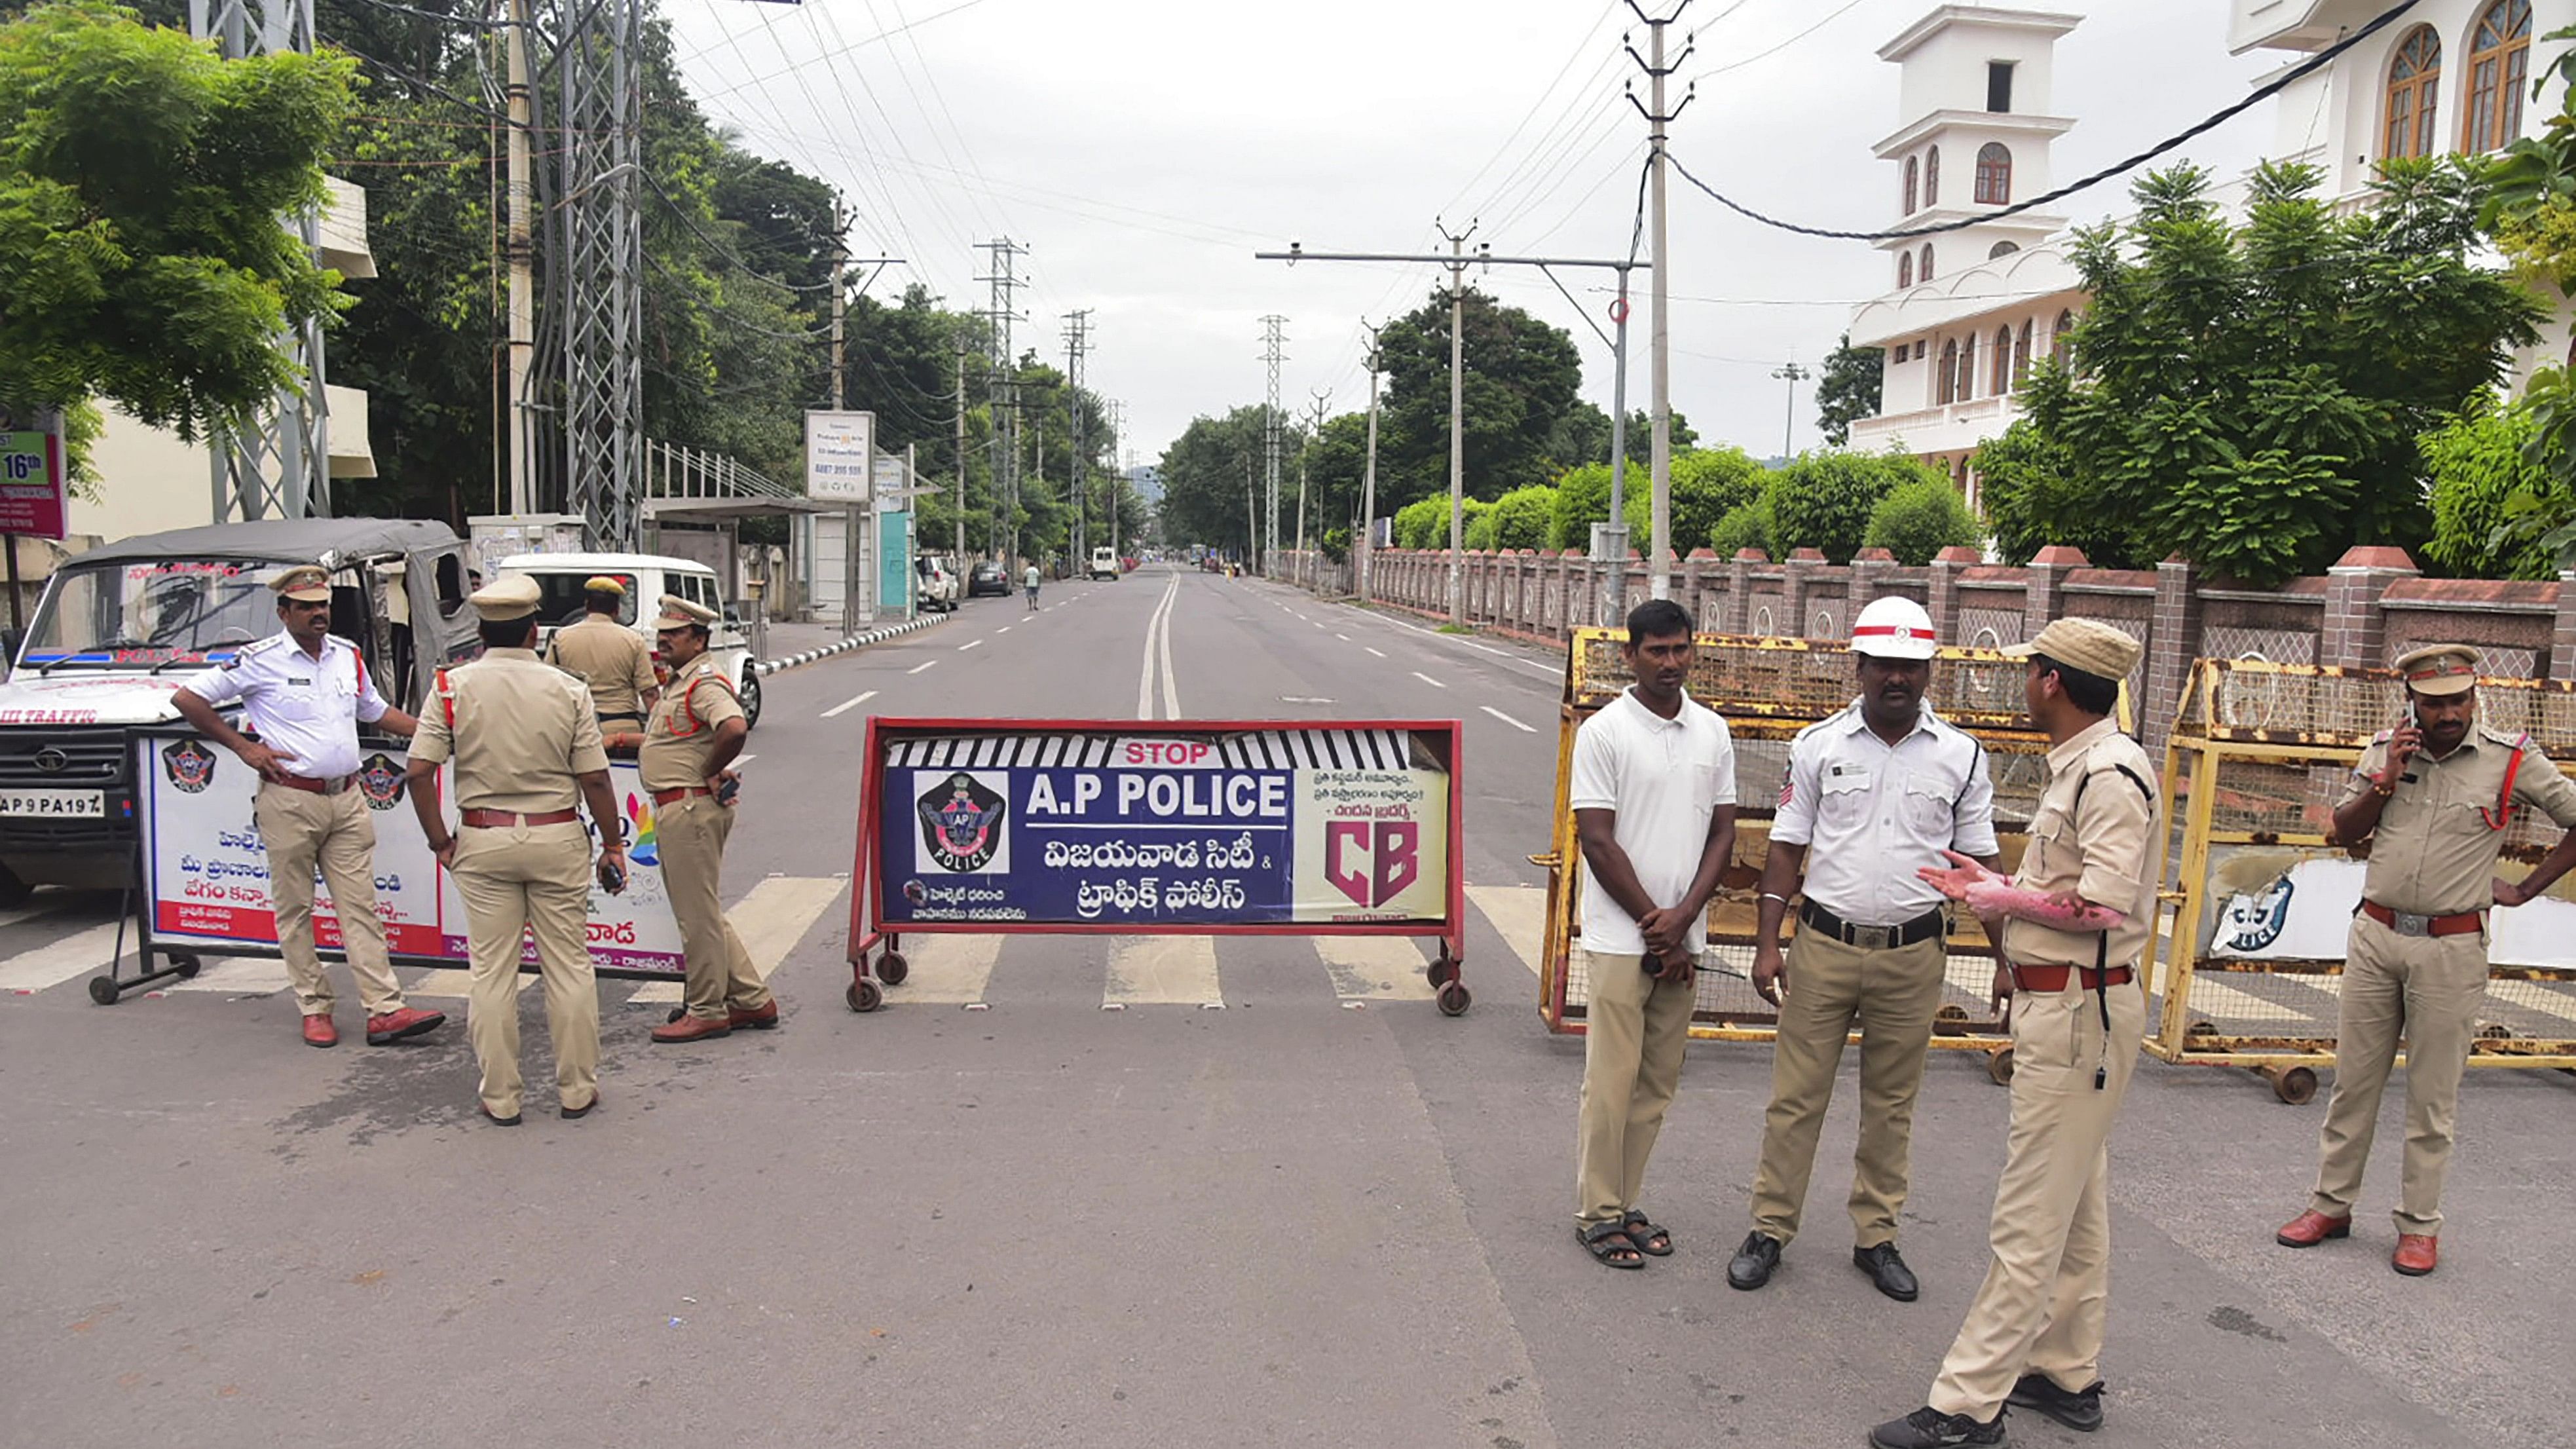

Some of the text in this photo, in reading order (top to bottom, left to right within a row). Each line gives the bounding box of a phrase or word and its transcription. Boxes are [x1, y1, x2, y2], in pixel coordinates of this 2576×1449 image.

[4, 454, 41, 479] 16th
[25, 709, 97, 723] TRAFFIC
[1125, 743, 1208, 764] STOP
[1026, 774, 1286, 817] A.P POLICE
[953, 814, 969, 825] AP
[934, 848, 990, 870] POLICE
[1044, 831, 1272, 869] విజయవాడ సిటీ &
[1324, 821, 1418, 909] CB
[1076, 877, 1159, 918] ట్రాఫిక్
